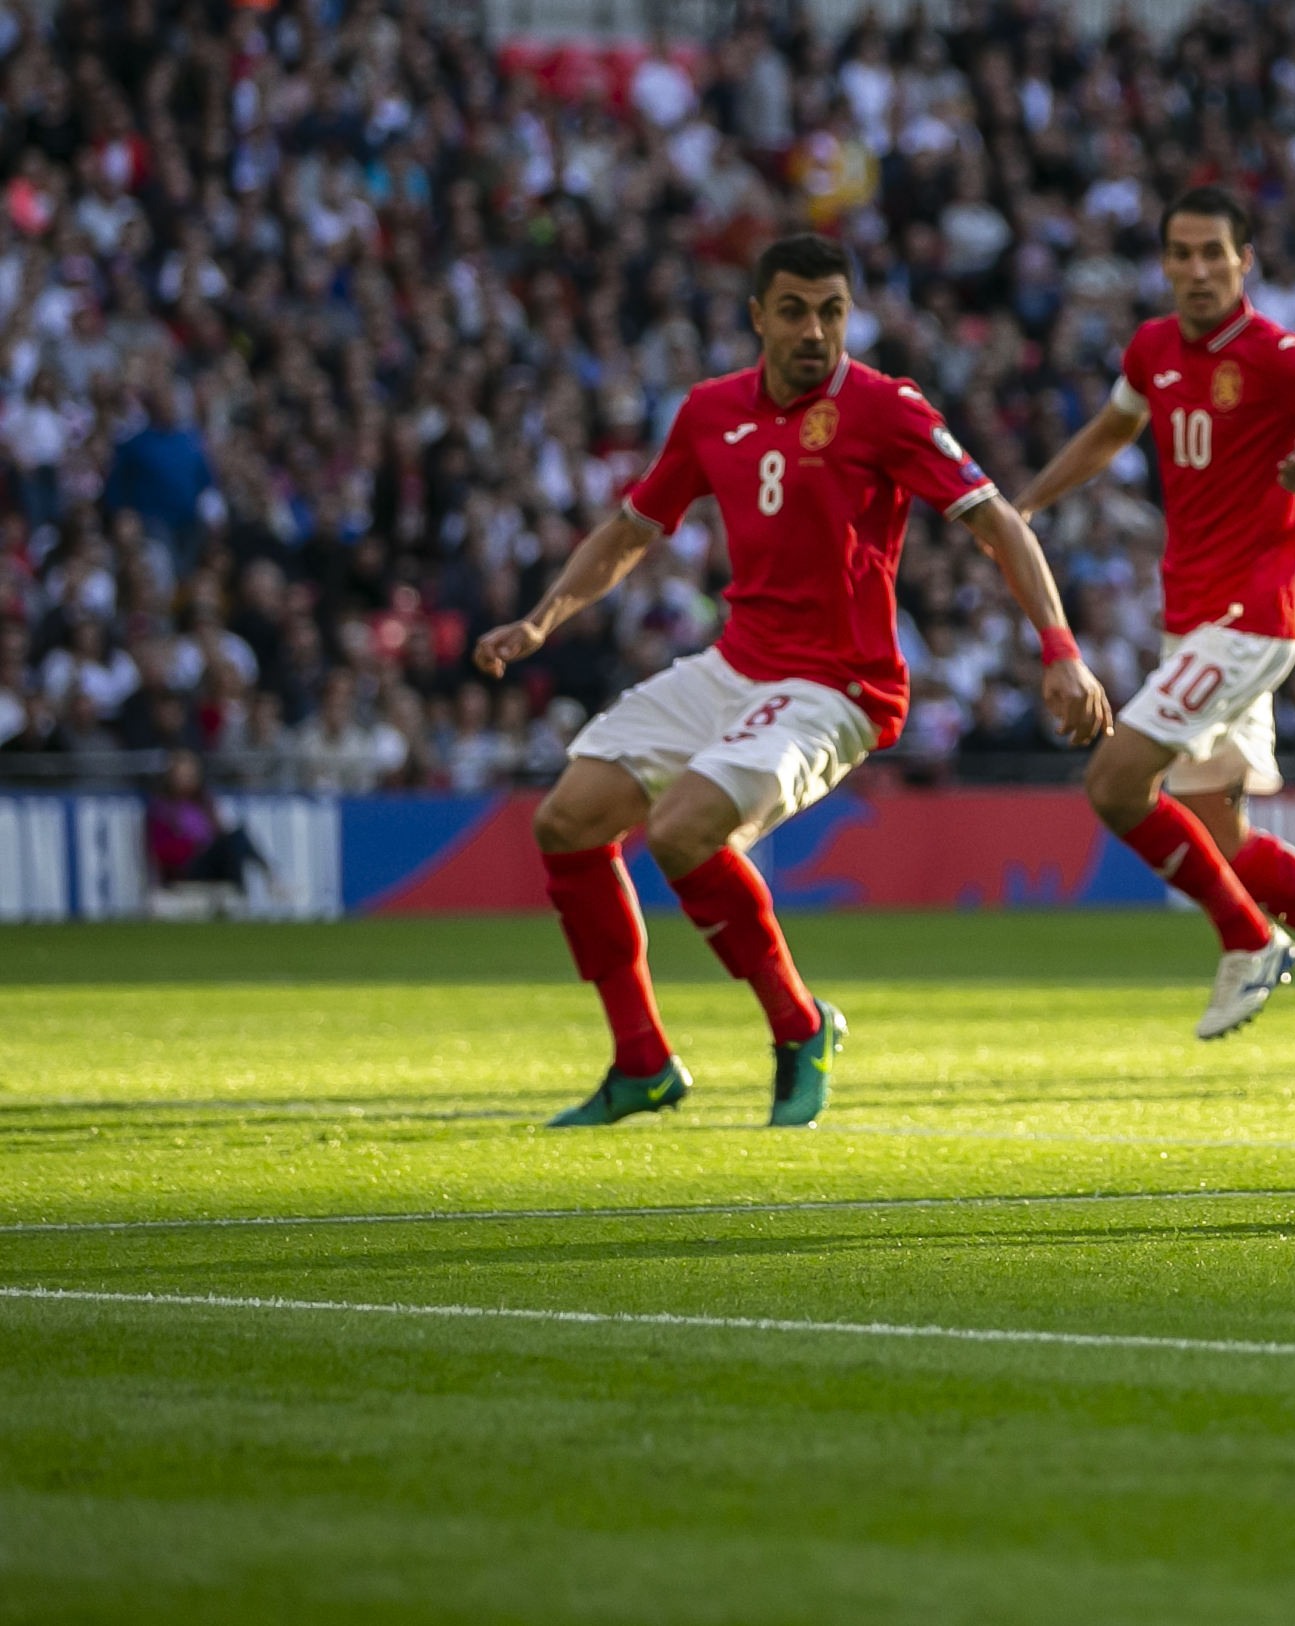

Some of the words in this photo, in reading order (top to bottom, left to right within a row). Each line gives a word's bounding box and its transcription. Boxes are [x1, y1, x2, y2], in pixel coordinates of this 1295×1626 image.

[1170, 405, 1213, 471] 10
[757, 449, 786, 517] 8
[745, 694, 791, 726] 8
[1159, 652, 1224, 713] 10
